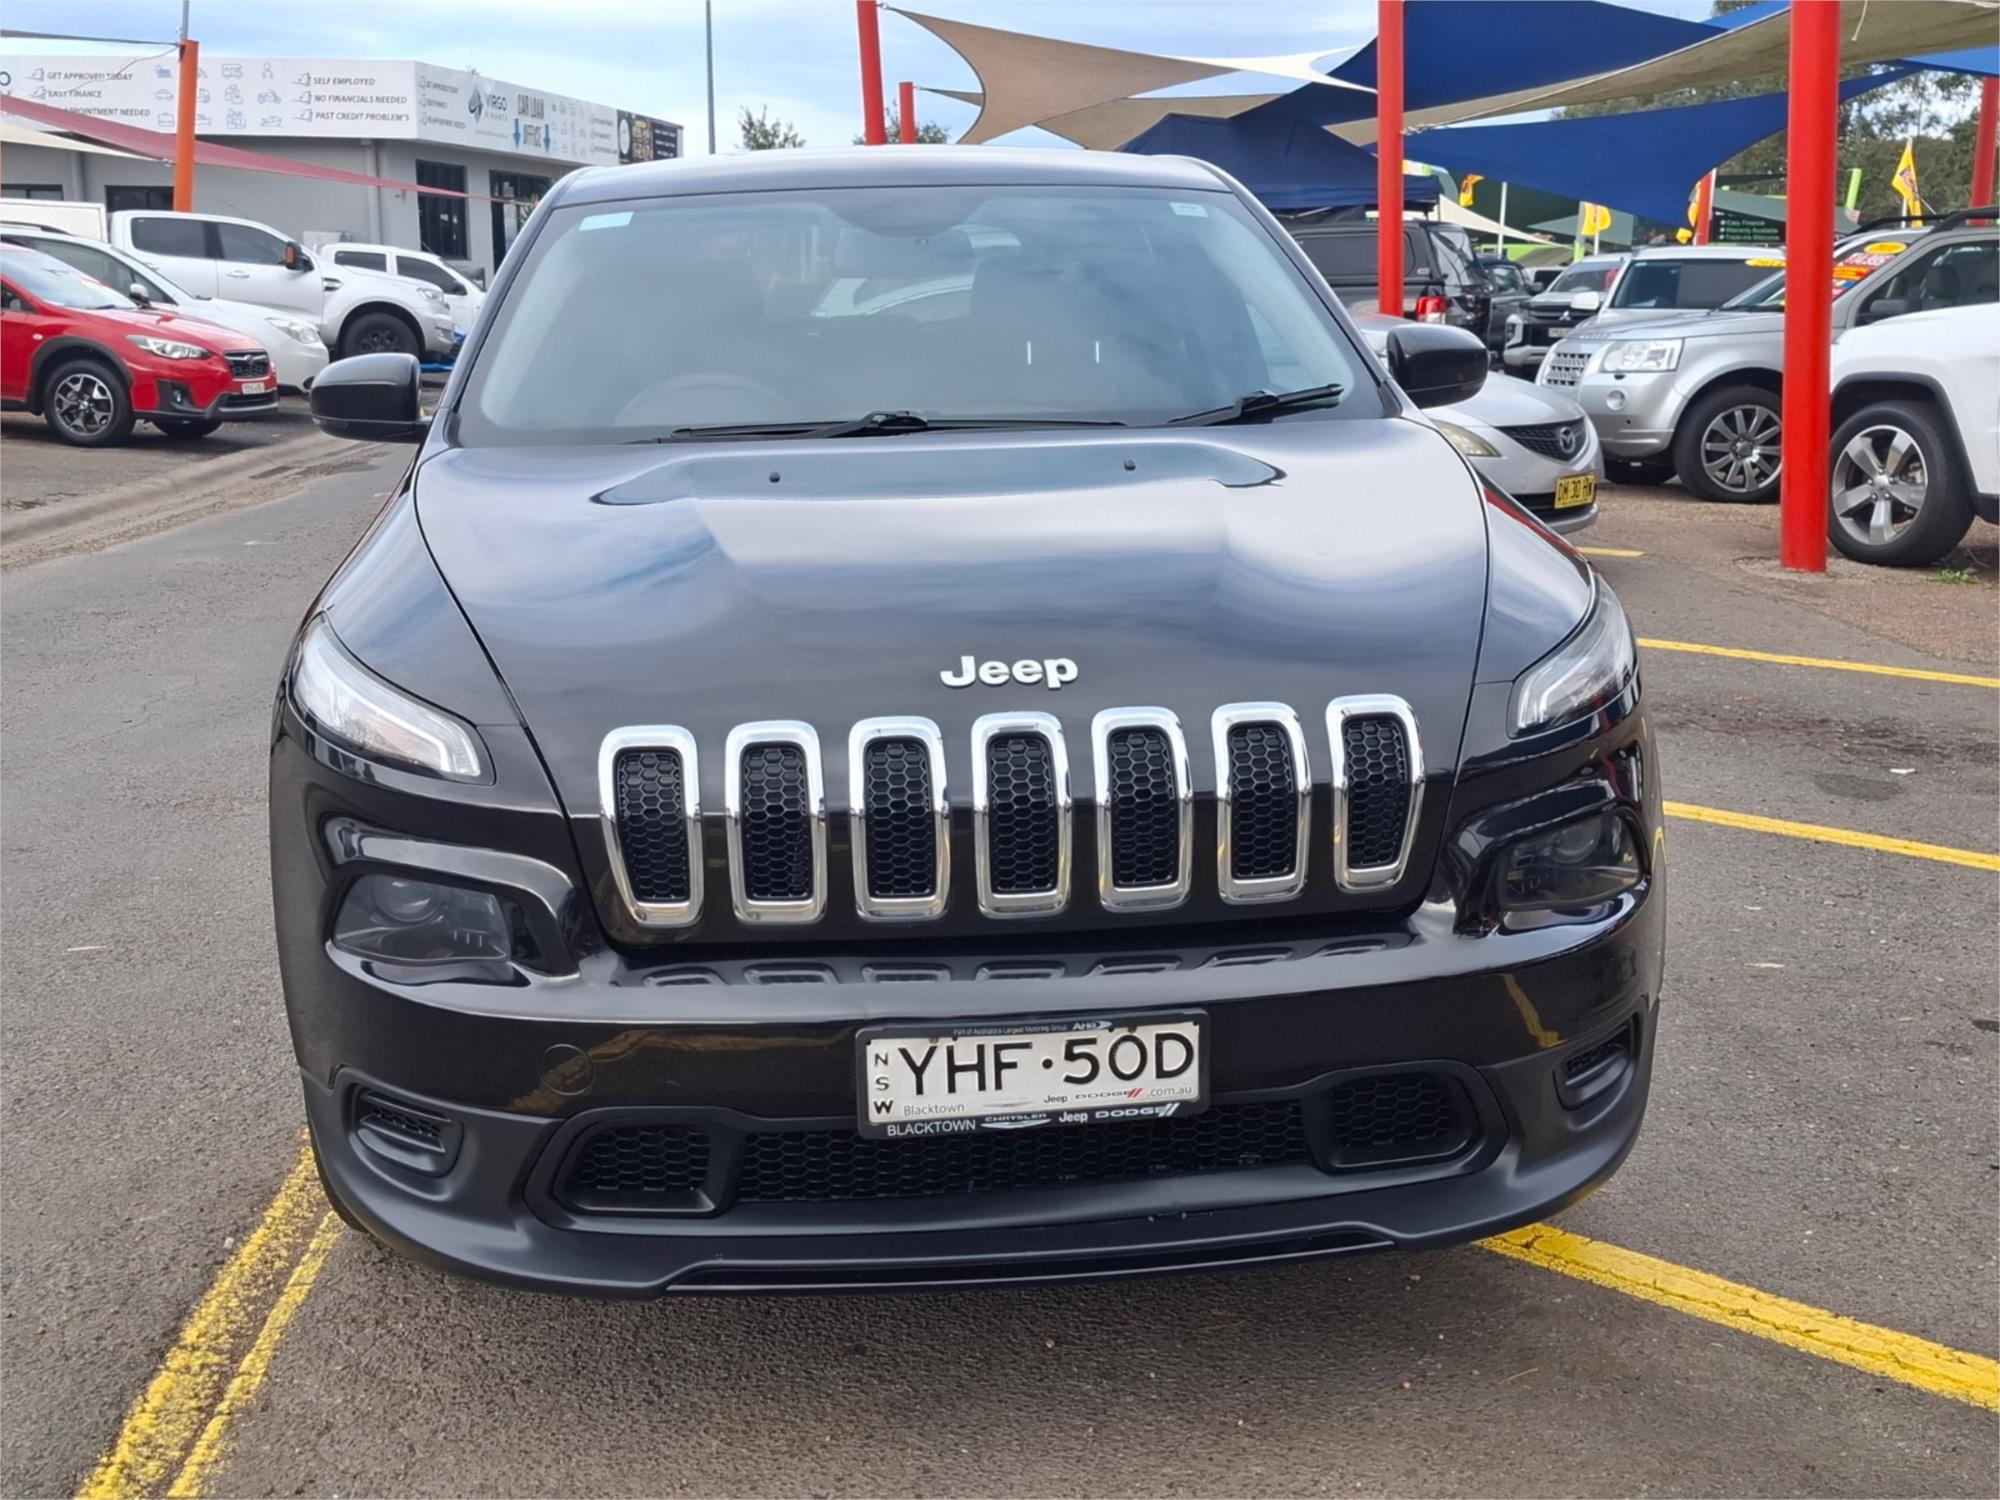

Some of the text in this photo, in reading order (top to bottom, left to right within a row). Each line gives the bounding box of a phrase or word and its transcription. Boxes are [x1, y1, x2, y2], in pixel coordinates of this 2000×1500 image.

[47, 72, 62, 80] GET
[64, 72, 105, 80] APPROVED
[313, 77, 376, 86] SELF EMPLOYED
[48, 90, 102, 98] EASY FINANCE
[314, 95, 408, 104] NO FINANCIALS NEEDED
[485, 93, 507, 111] VIRGO
[517, 94, 545, 119] CAR LOAN
[120, 108, 151, 117] NEEDED
[315, 112, 410, 121] PAST CREDIT PROBLEM'S
[523, 123, 542, 148] OFFICE
[940, 655, 1079, 690] Jeep
[953, 1028, 965, 1036] Part
[1003, 1025, 1024, 1035] Largest
[1025, 1024, 1050, 1033] Motoring
[904, 1104, 965, 1116] Blacktown
[1044, 1094, 1068, 1103] Jeep
[1147, 1086, 1192, 1098] .com.au
[887, 1104, 1164, 1136] BLACKTOWN CHRYSLER Jeep DODGE
